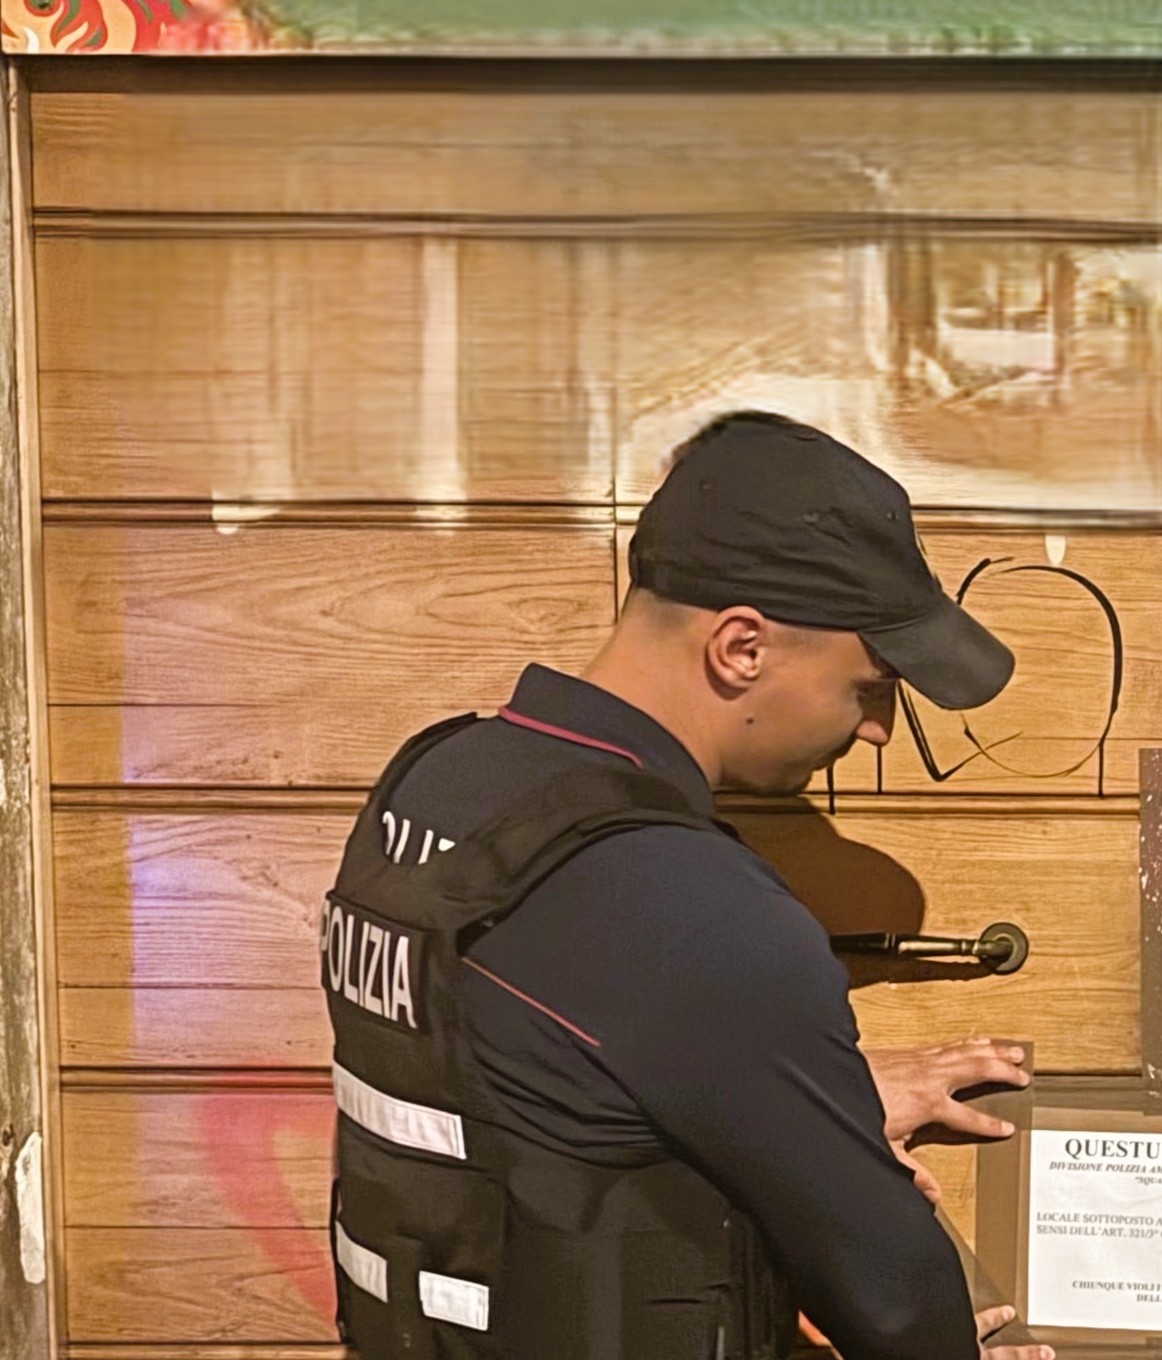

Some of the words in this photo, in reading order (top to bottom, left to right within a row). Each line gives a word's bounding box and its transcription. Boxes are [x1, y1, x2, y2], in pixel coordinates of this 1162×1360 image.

[1049, 1161, 1103, 1172] DIVISIONE
[1105, 1163, 1147, 1174] POLIZIA
[1037, 1212, 1081, 1222] LOCALE
[1082, 1214, 1154, 1226] SOTTOPOSTO
[1036, 1224, 1068, 1235] SENSI
[1072, 1280, 1125, 1291] CHIUNQUE
[1126, 1282, 1155, 1292] VIOLI
[1156, 1283, 1161, 1292] I
